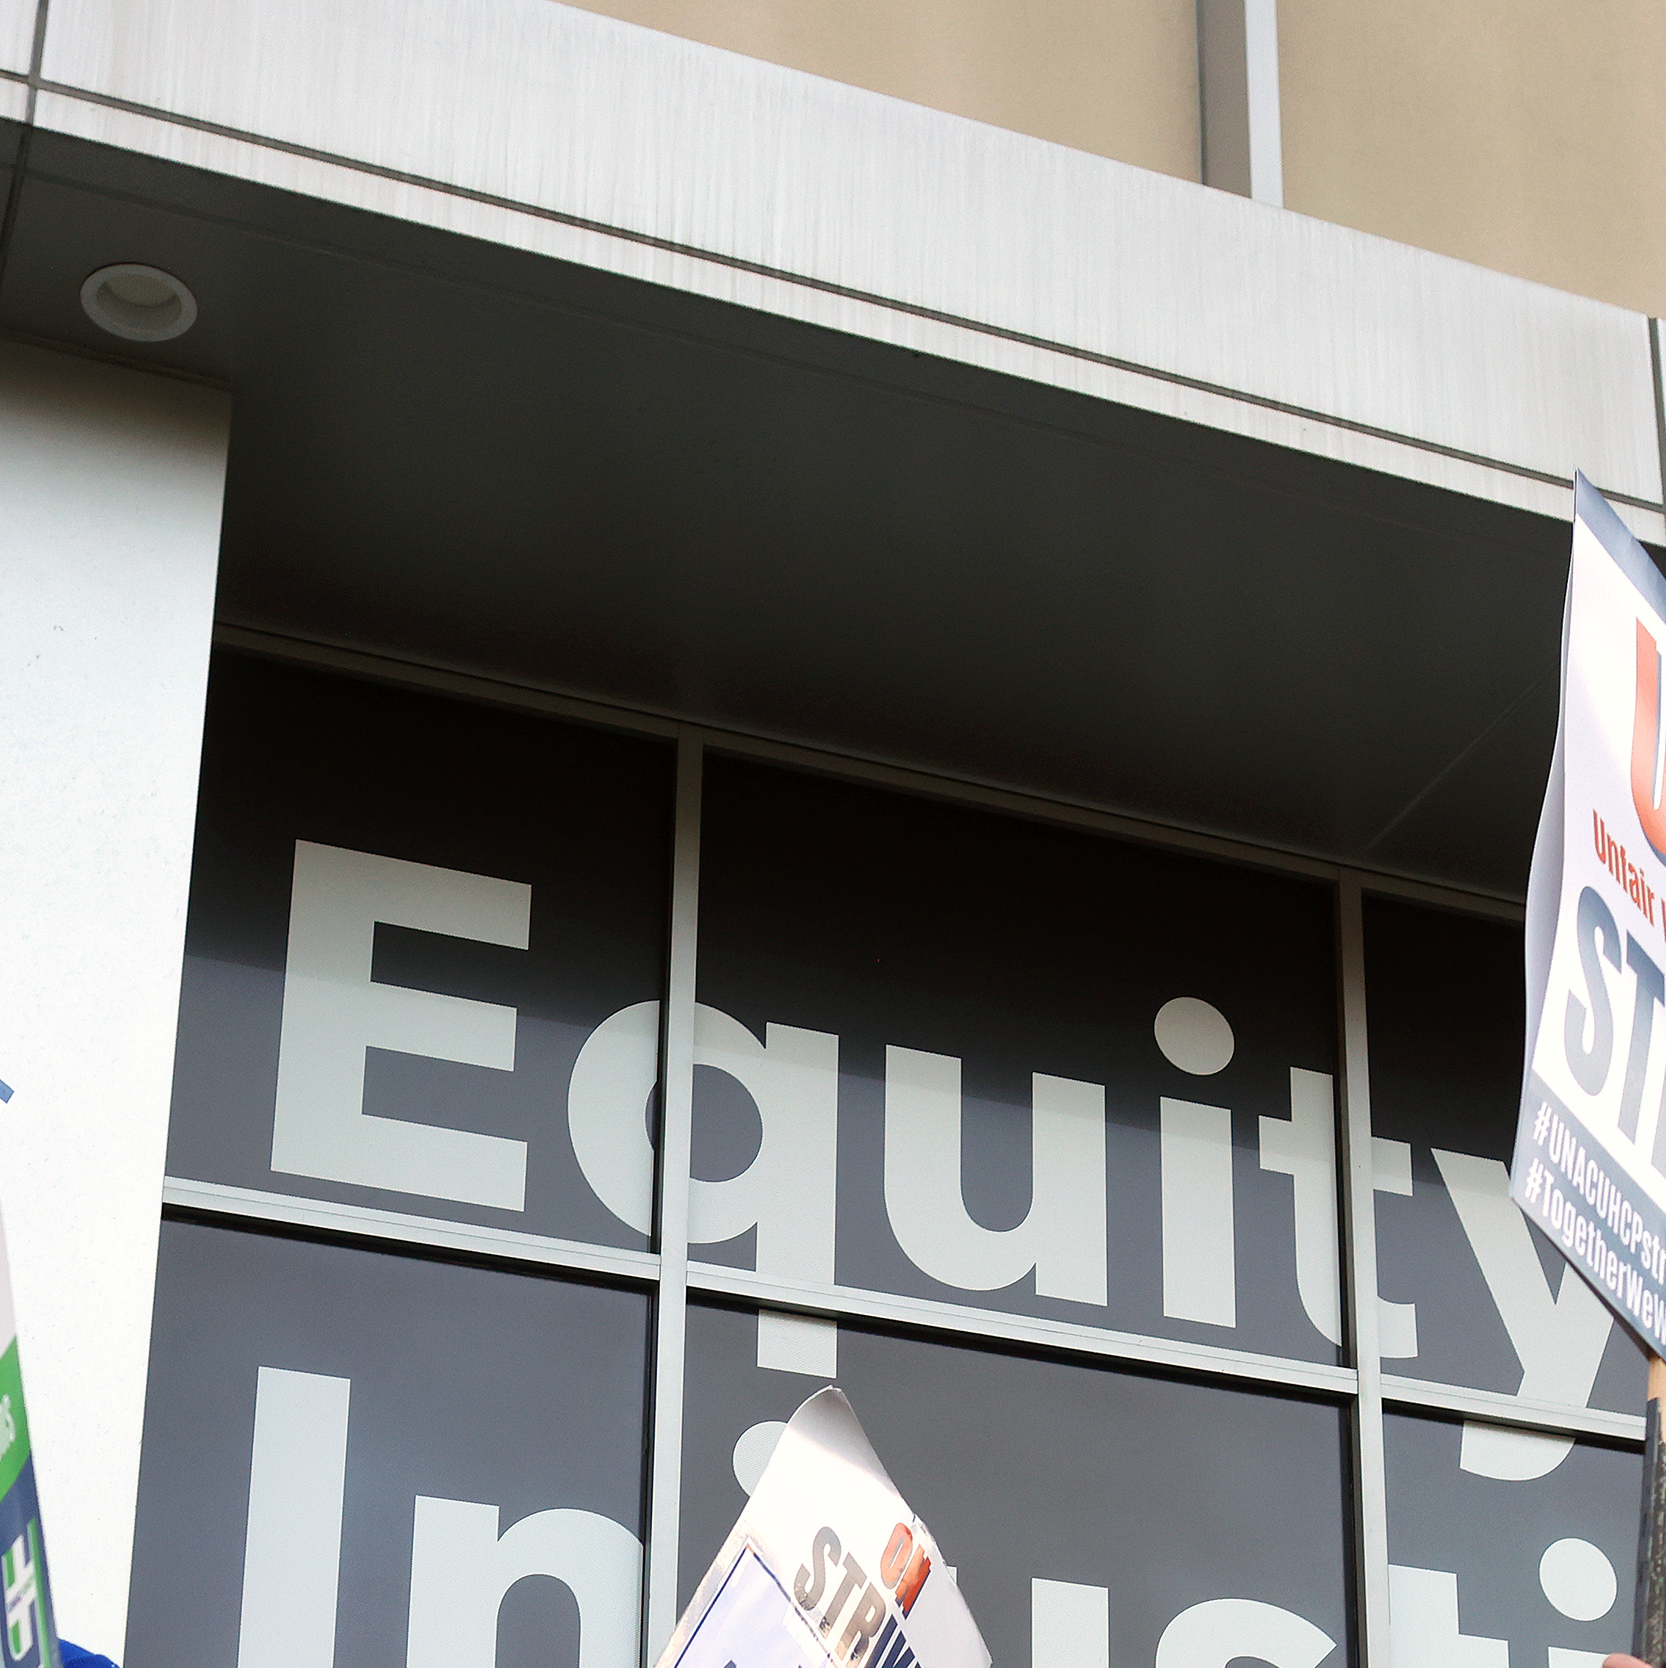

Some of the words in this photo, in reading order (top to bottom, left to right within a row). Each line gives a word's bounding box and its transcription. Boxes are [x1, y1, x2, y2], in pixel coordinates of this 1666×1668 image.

[1593, 808, 1655, 927] Unfair
[270, 840, 1614, 1482] Equity
[879, 1521, 932, 1621] ON
